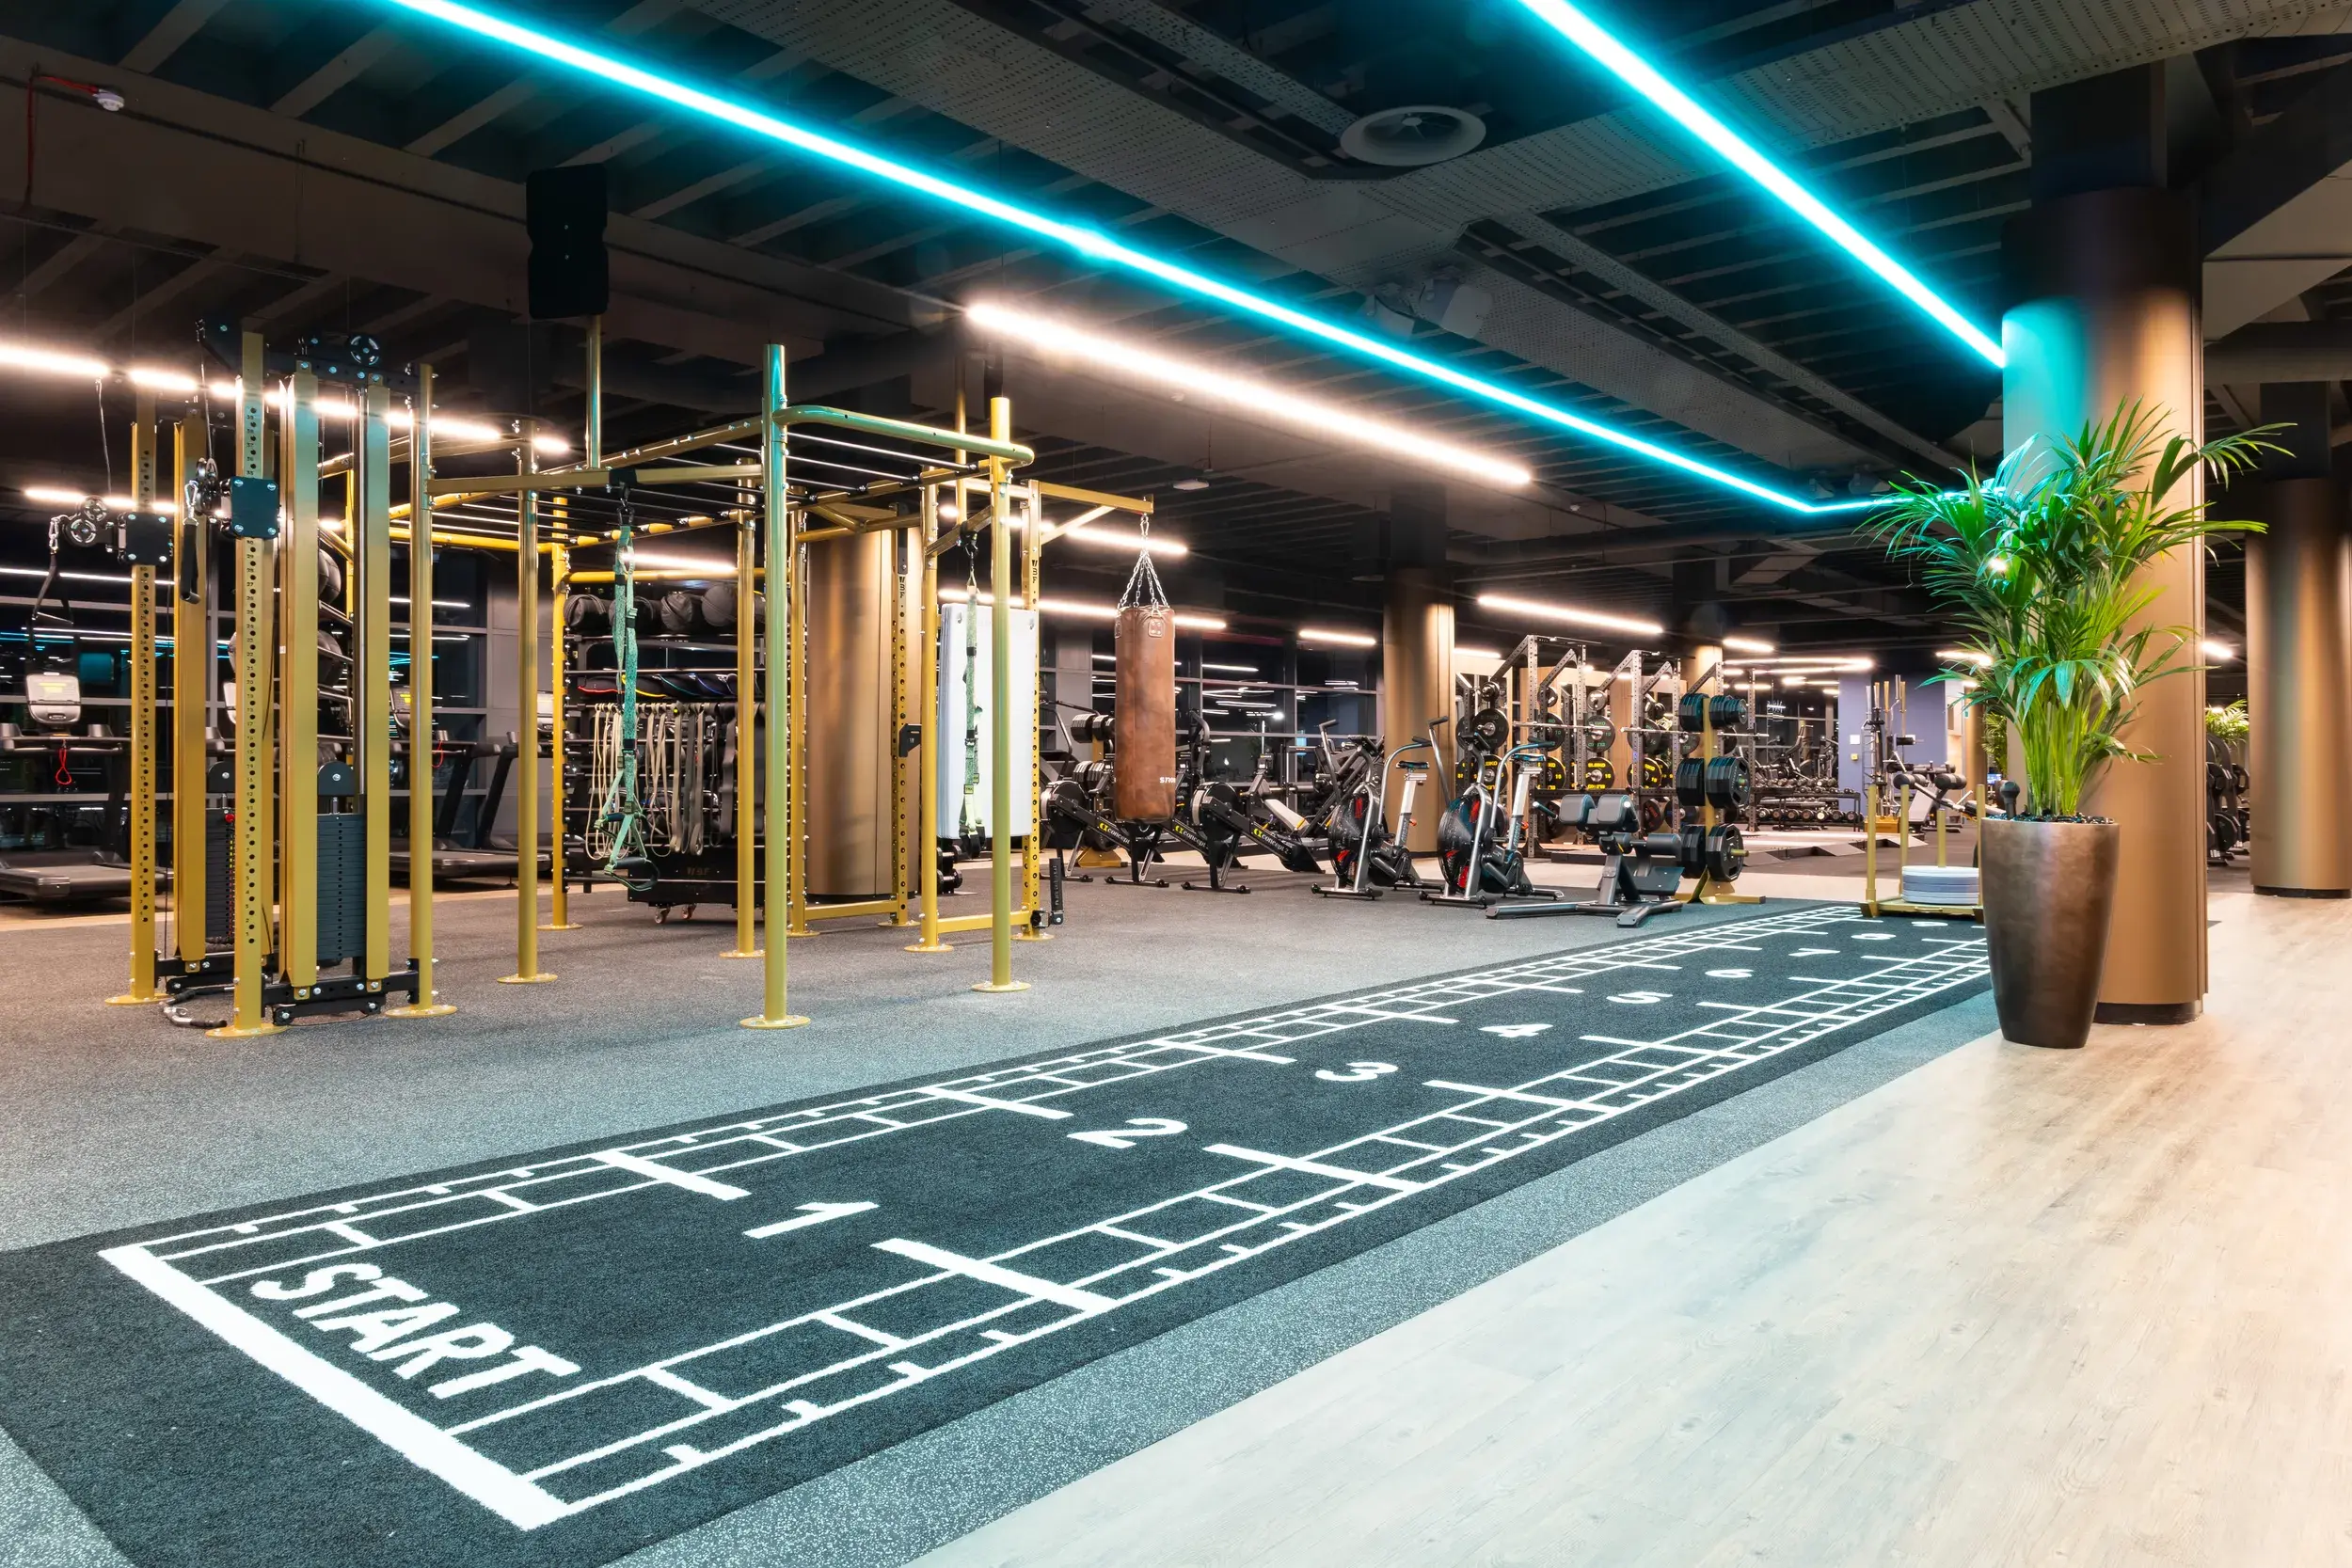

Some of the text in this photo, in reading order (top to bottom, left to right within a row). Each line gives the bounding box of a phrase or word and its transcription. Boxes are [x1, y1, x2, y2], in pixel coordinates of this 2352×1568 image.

[1788, 948, 1840, 957] 7
[1705, 969, 1755, 979] 6
[1605, 990, 1674, 1005] 5
[1478, 1023, 1554, 1038] 4
[1315, 1061, 1399, 1083] 3
[1067, 1117, 1188, 1149] 2
[743, 1200, 880, 1240] 1
[249, 1263, 582, 1400] START
